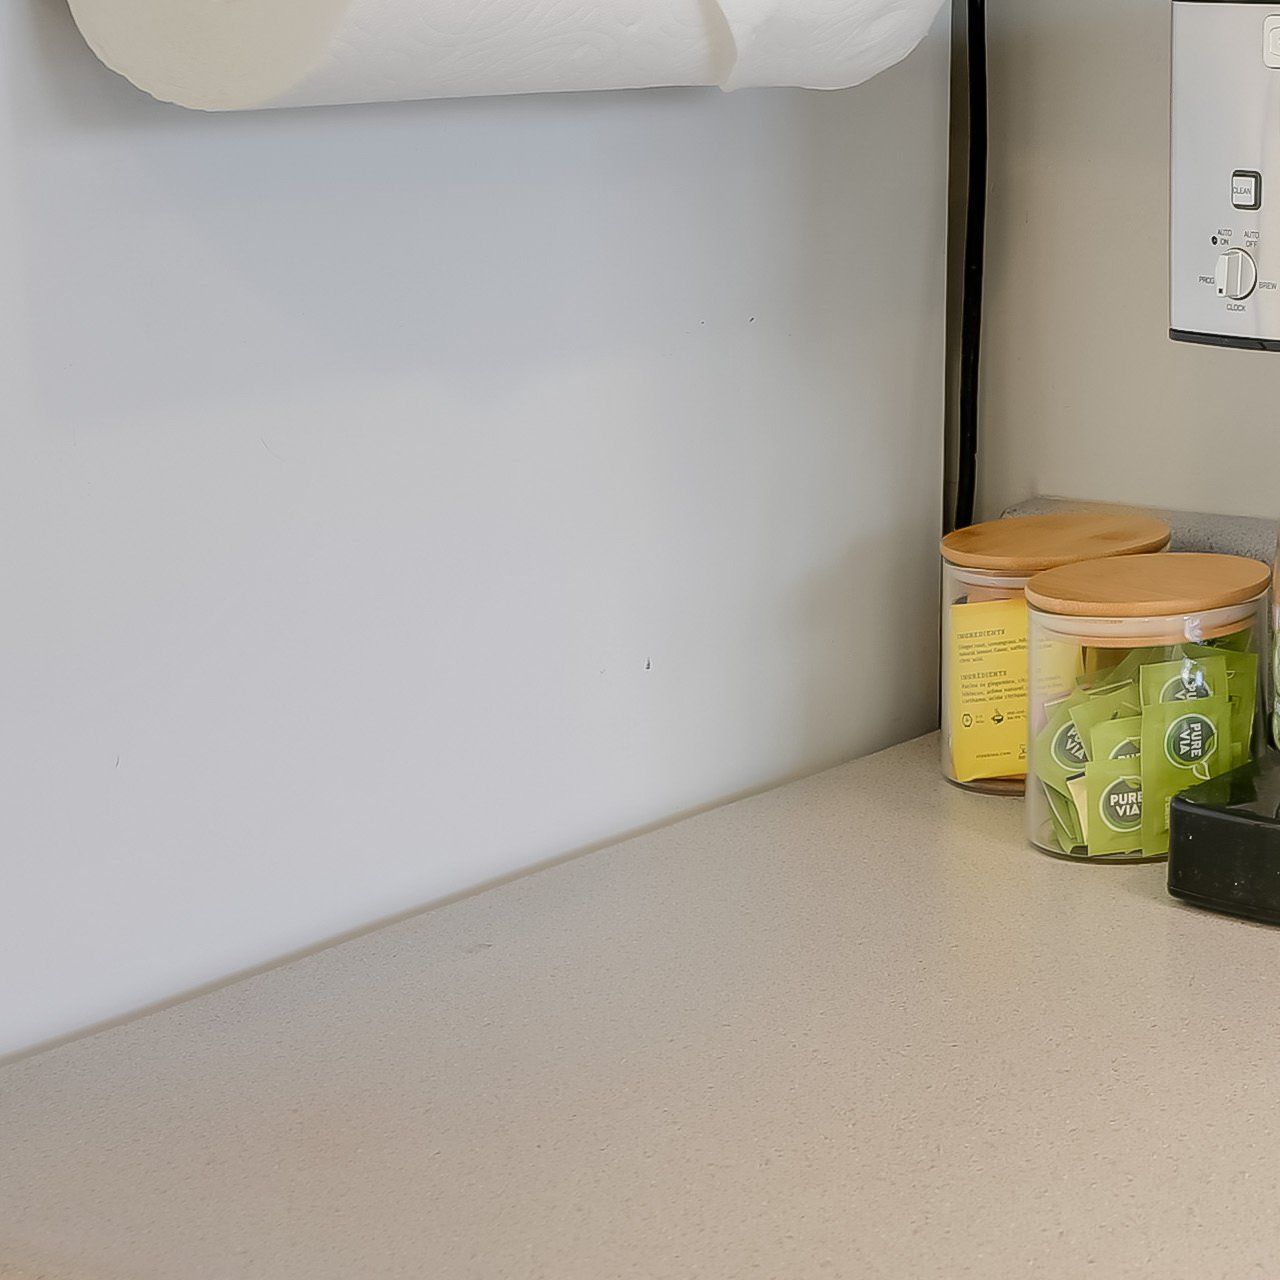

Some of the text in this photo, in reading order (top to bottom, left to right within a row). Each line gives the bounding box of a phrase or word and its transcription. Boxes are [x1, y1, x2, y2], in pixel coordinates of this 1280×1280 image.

[1232, 186, 1252, 196] CLEAN
[1217, 229, 1232, 238] AUTO
[1243, 231, 1260, 240] AUTO
[1219, 238, 1230, 246] ON
[1245, 240, 1259, 248] OFF
[1199, 276, 1215, 286] PROG
[1258, 281, 1278, 290] BREW
[1226, 303, 1246, 312] CLOCK
[1179, 729, 1191, 755] VIA
[1190, 722, 1203, 758] PURE
[1065, 739, 1087, 760] VIA
[1109, 791, 1143, 807] PURE
[1115, 806, 1141, 817] VIA
